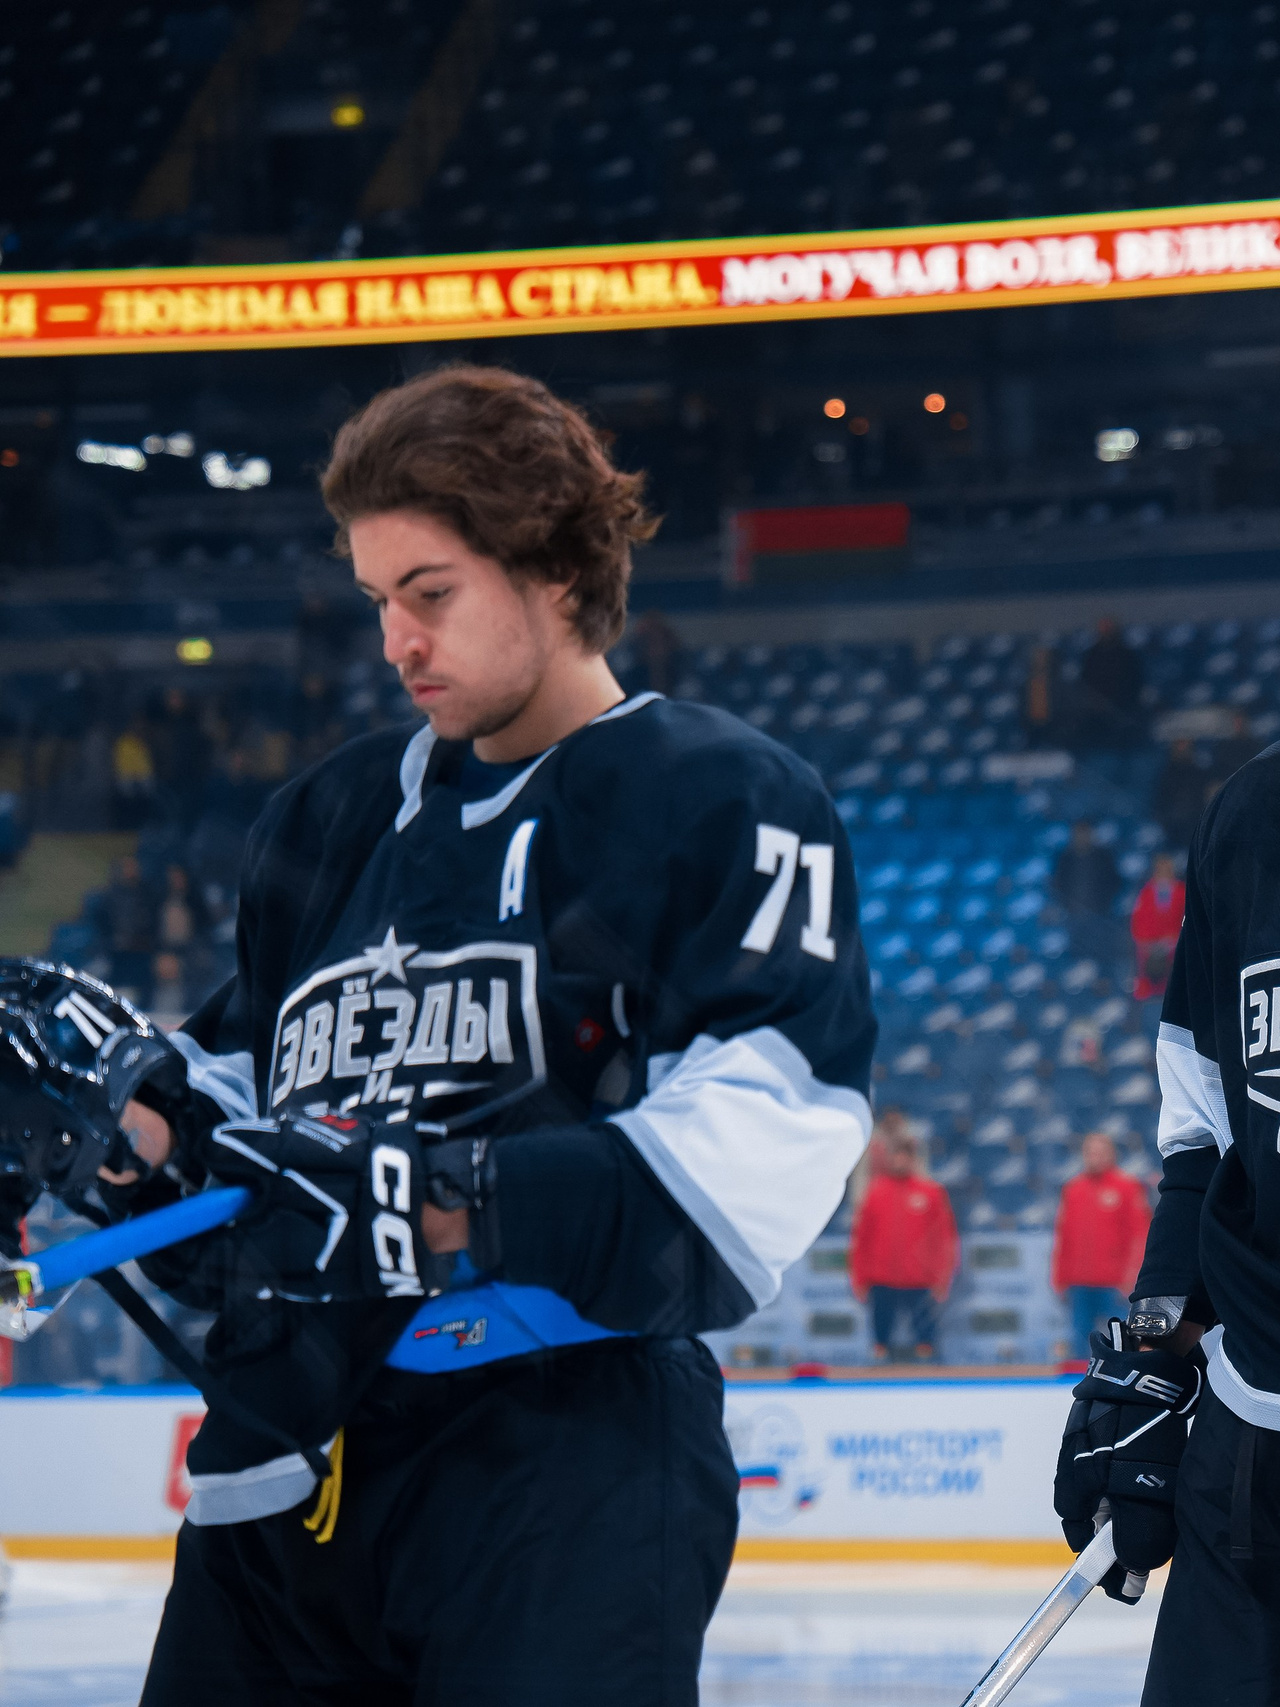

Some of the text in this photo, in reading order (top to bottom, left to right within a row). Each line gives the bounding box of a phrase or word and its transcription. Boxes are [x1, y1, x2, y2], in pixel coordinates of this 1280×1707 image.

[355, 271, 505, 326] НАША
[721, 246, 958, 306] МОГУЧАЯ
[740, 822, 836, 963] 71
[272, 977, 514, 1108] ЗВЁЗДЫ
[360, 1069, 393, 1105] И
[828, 1430, 1003, 1458] МИНСПОРТ
[853, 1467, 983, 1496] РОССИИ
